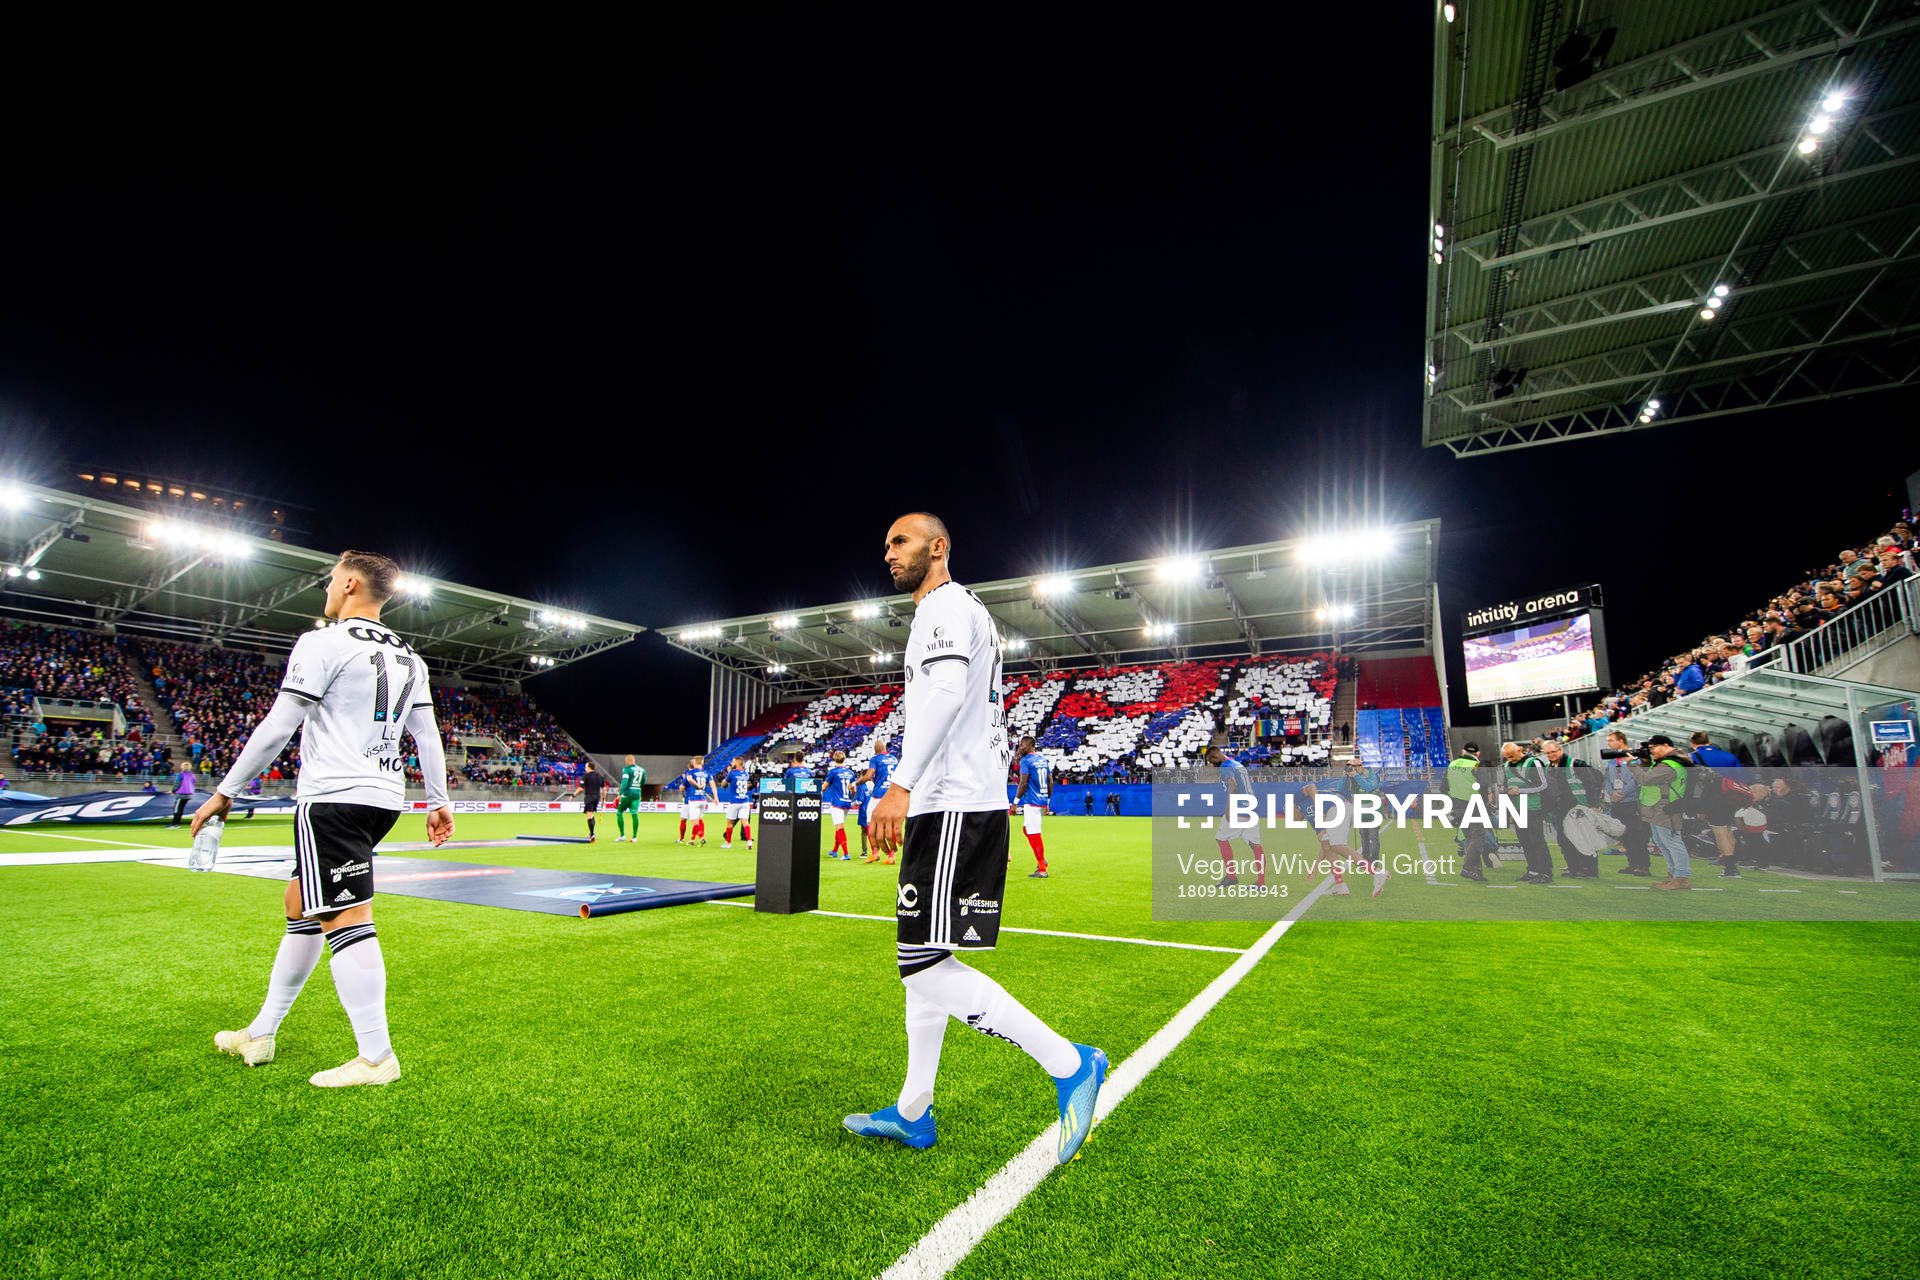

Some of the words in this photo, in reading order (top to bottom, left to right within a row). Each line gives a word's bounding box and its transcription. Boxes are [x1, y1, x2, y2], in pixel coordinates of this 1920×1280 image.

[1467, 602, 1519, 627] intility
[1525, 590, 1579, 613] arena
[369, 651, 416, 723] 17
[1037, 767, 1048, 789] 10
[736, 780, 748, 794] 33
[454, 802, 486, 812] PSS
[518, 802, 547, 812] PSS
[640, 803, 656, 811] SS
[762, 796, 790, 808] altibox
[796, 796, 820, 808] altibox
[763, 811, 788, 822] coop
[798, 811, 819, 822] coop
[959, 897, 999, 908] NORGESHUS
